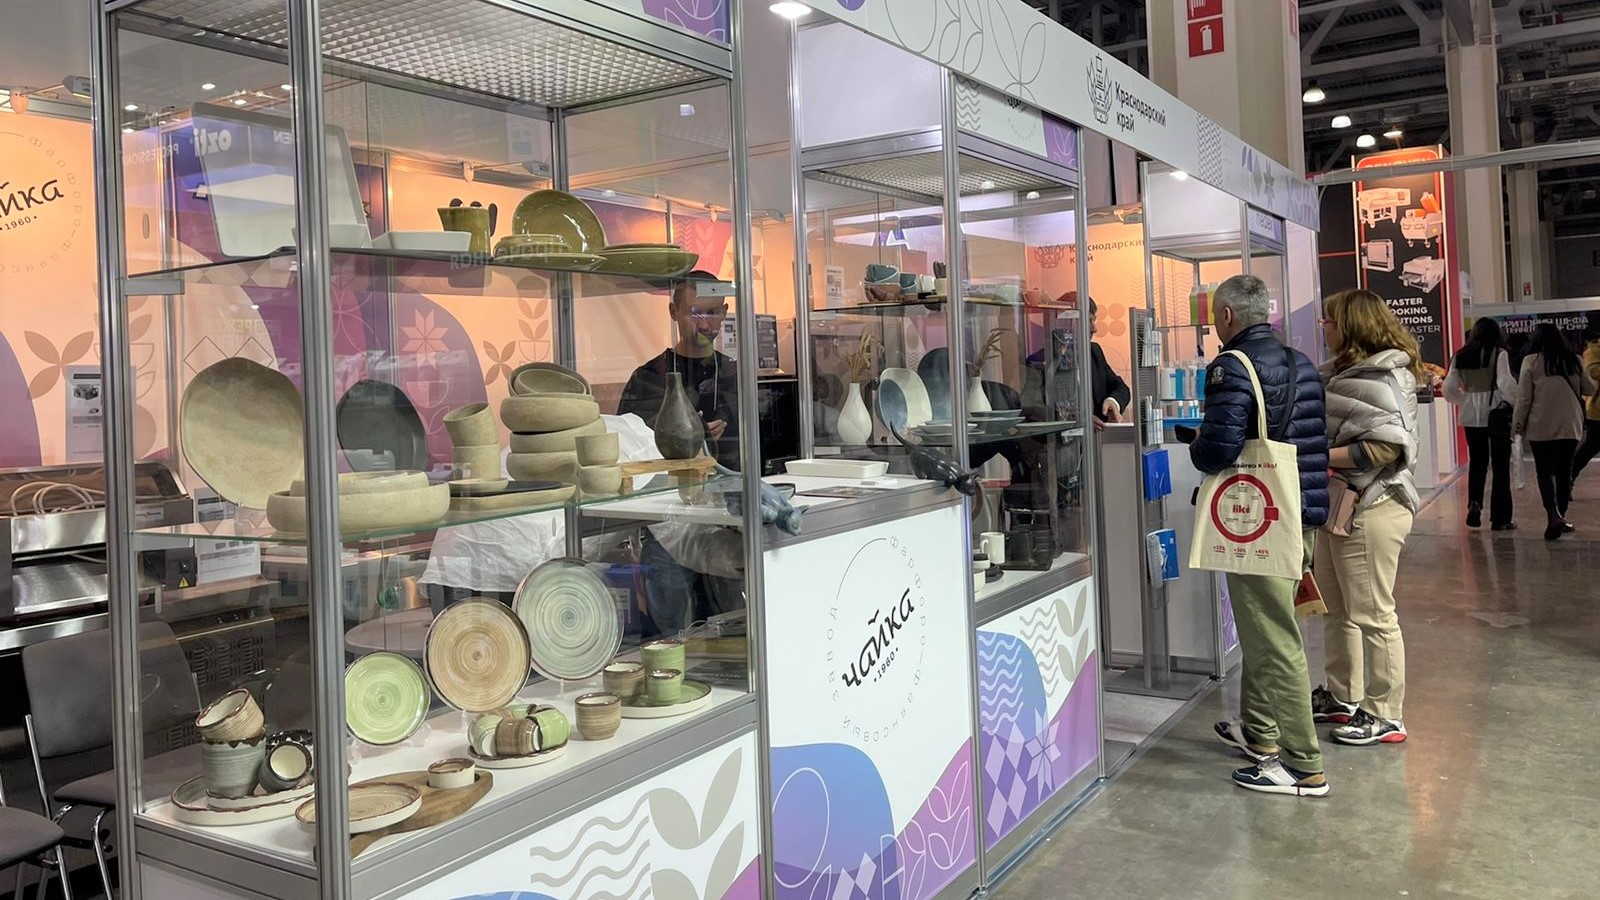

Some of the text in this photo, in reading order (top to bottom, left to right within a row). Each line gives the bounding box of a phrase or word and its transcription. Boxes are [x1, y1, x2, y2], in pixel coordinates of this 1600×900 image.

[1115, 81, 1166, 128] Краснодарский
[1117, 111, 1135, 132] край
[0, 179, 64, 217] йка
[1386, 298, 1423, 306] FASTER
[1391, 307, 1428, 315] OOKING
[1399, 316, 1433, 324] UTIONS
[1408, 325, 1440, 333] ASTER
[842, 588, 915, 687] чайка
